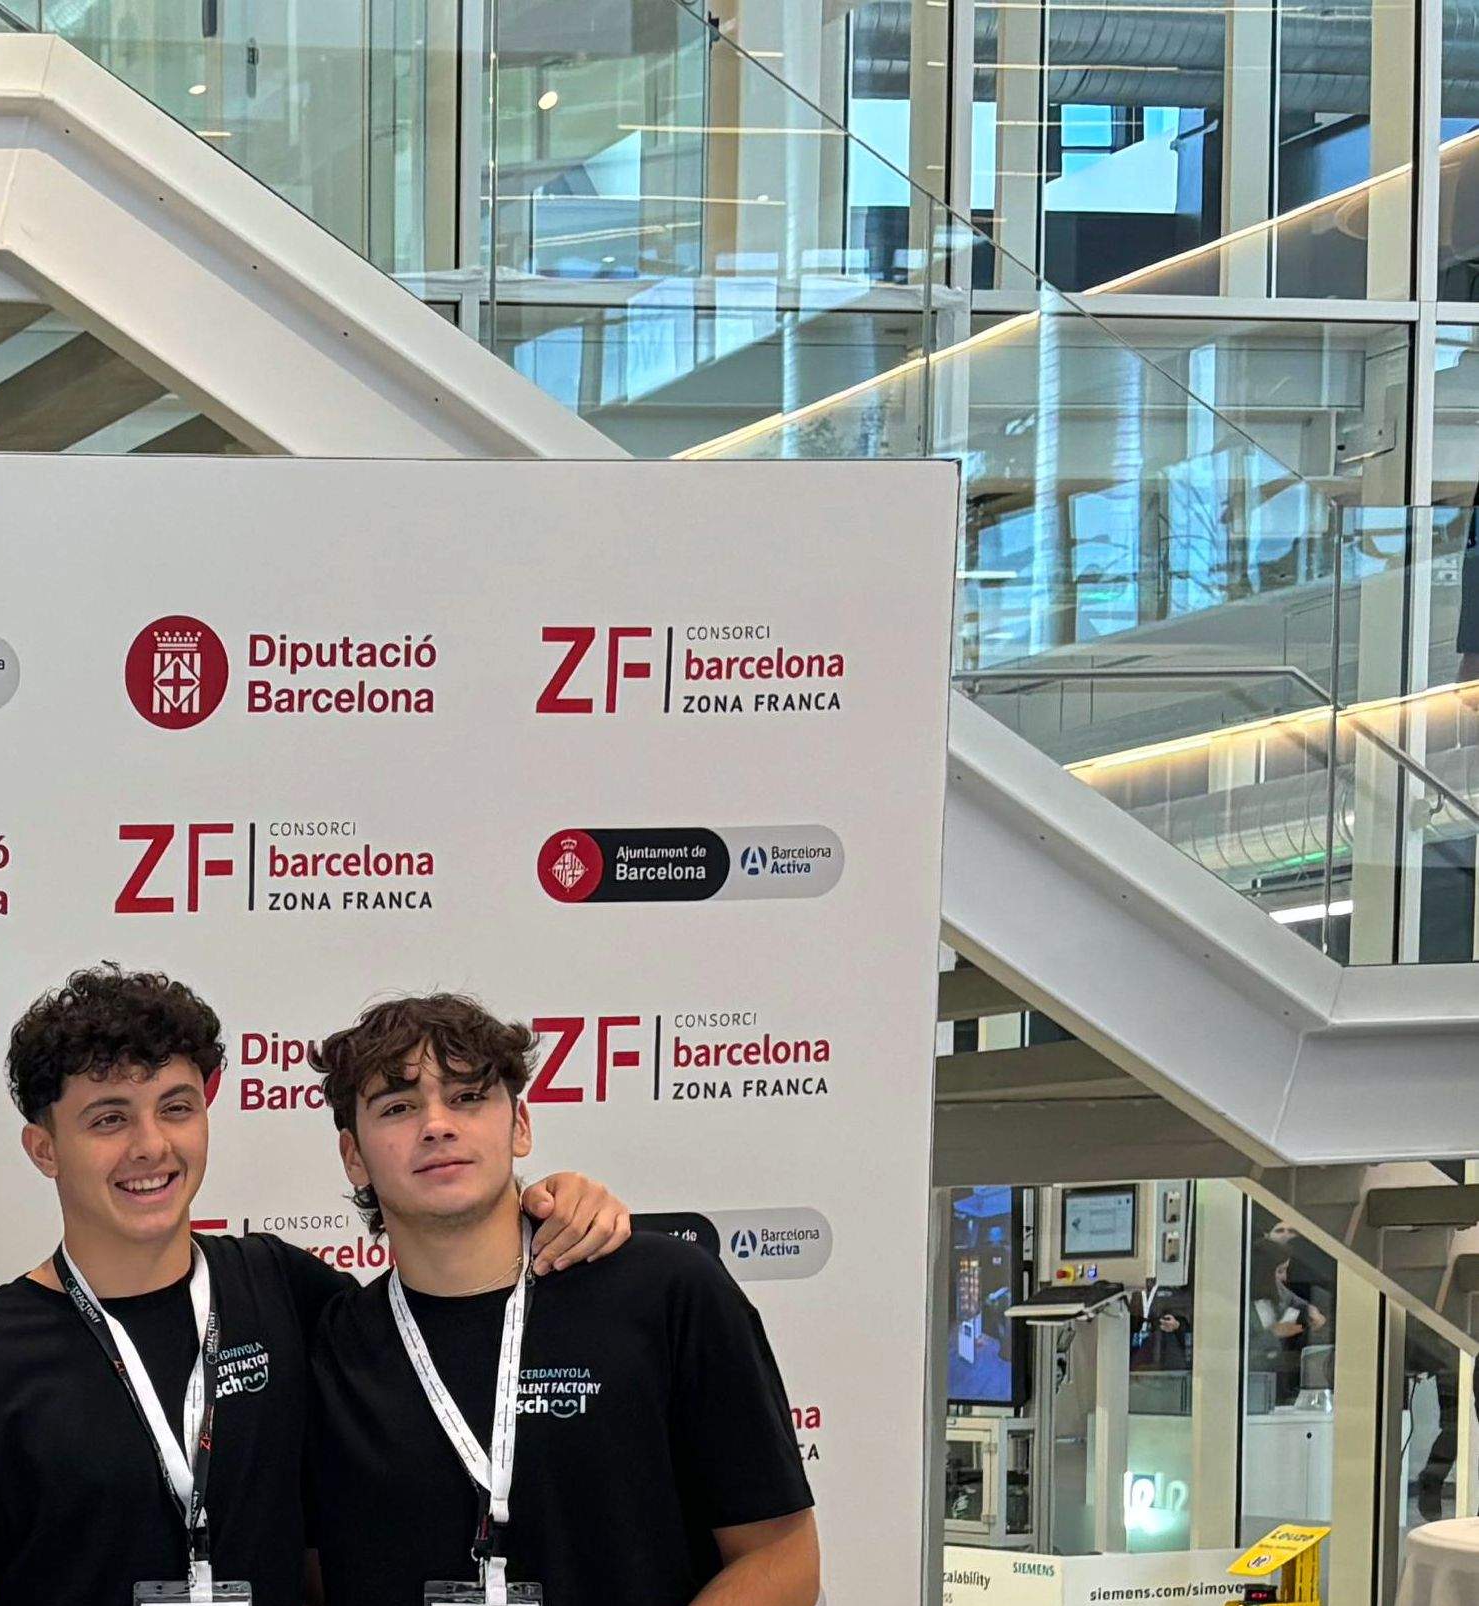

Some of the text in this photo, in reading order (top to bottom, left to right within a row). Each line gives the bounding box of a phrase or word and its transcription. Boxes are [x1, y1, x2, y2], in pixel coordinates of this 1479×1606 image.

[687, 626, 769, 640] CONSORCI
[249, 634, 436, 674] Diputació
[536, 627, 652, 713] ZF
[685, 647, 843, 680] barcelona
[248, 681, 433, 713] Barcelona
[683, 693, 840, 713] ZONA FRANCA
[270, 821, 355, 837] CONSORCI
[270, 844, 433, 877] barcelona
[616, 845, 706, 862] Ajuntament de
[772, 846, 831, 859] Barcelona
[115, 823, 233, 913] ZF
[616, 863, 705, 880] Barcelona
[771, 860, 810, 874] Activa
[269, 891, 432, 910] ZONA FRANCA
[675, 1012, 756, 1028] CONSORCI
[524, 1016, 640, 1103] ZF
[674, 1034, 829, 1067] barcelona
[673, 1078, 827, 1100] ZONA FRANCA
[264, 1215, 349, 1230] CONSORCI
[761, 1228, 820, 1242] Barcelona
[761, 1243, 800, 1256] Activa
[520, 1368, 591, 1379] CERDANYOLA
[517, 1382, 602, 1394] ALENT FACTORY
[516, 1395, 586, 1418] school
[1013, 1561, 1055, 1577] SIEMENS
[943, 1570, 991, 1590] calability
